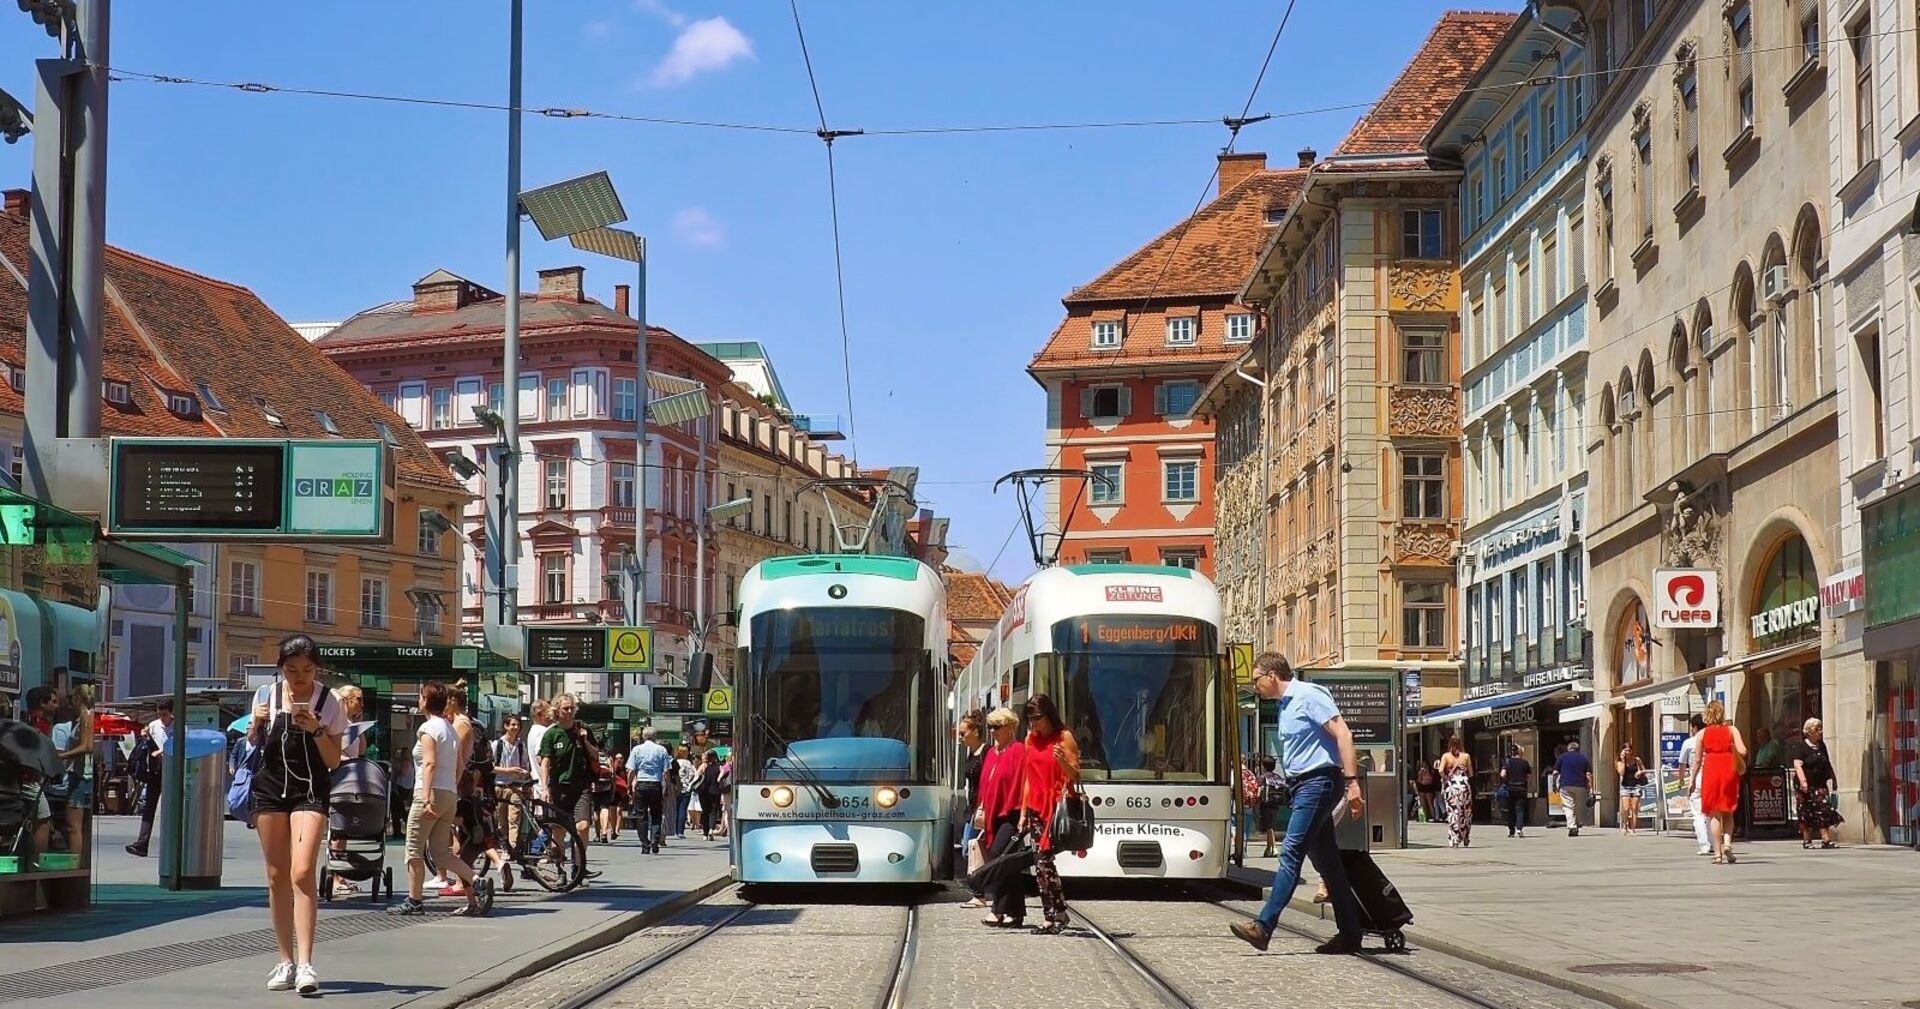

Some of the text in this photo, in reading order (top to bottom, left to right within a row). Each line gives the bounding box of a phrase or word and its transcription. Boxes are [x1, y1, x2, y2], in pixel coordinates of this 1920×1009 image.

[297, 480, 369, 496] GRAZ
[1109, 592, 1160, 600] ZEITUNG
[1820, 580, 1845, 608] TALLY
[1661, 609, 1712, 623] ruefa
[1751, 596, 1819, 638] THE BODY SHOP
[1081, 622, 1197, 642] 1 Eggenberg/UKH
[319, 647, 433, 657] TICKETS TICKETS
[1483, 706, 1535, 727] WEIKHARD
[1753, 789, 1782, 800] SALE
[1126, 797, 1152, 808] 663
[758, 809, 906, 819] www.schauspielhaus-graz.com
[1094, 823, 1184, 837] Meine Kleine.
